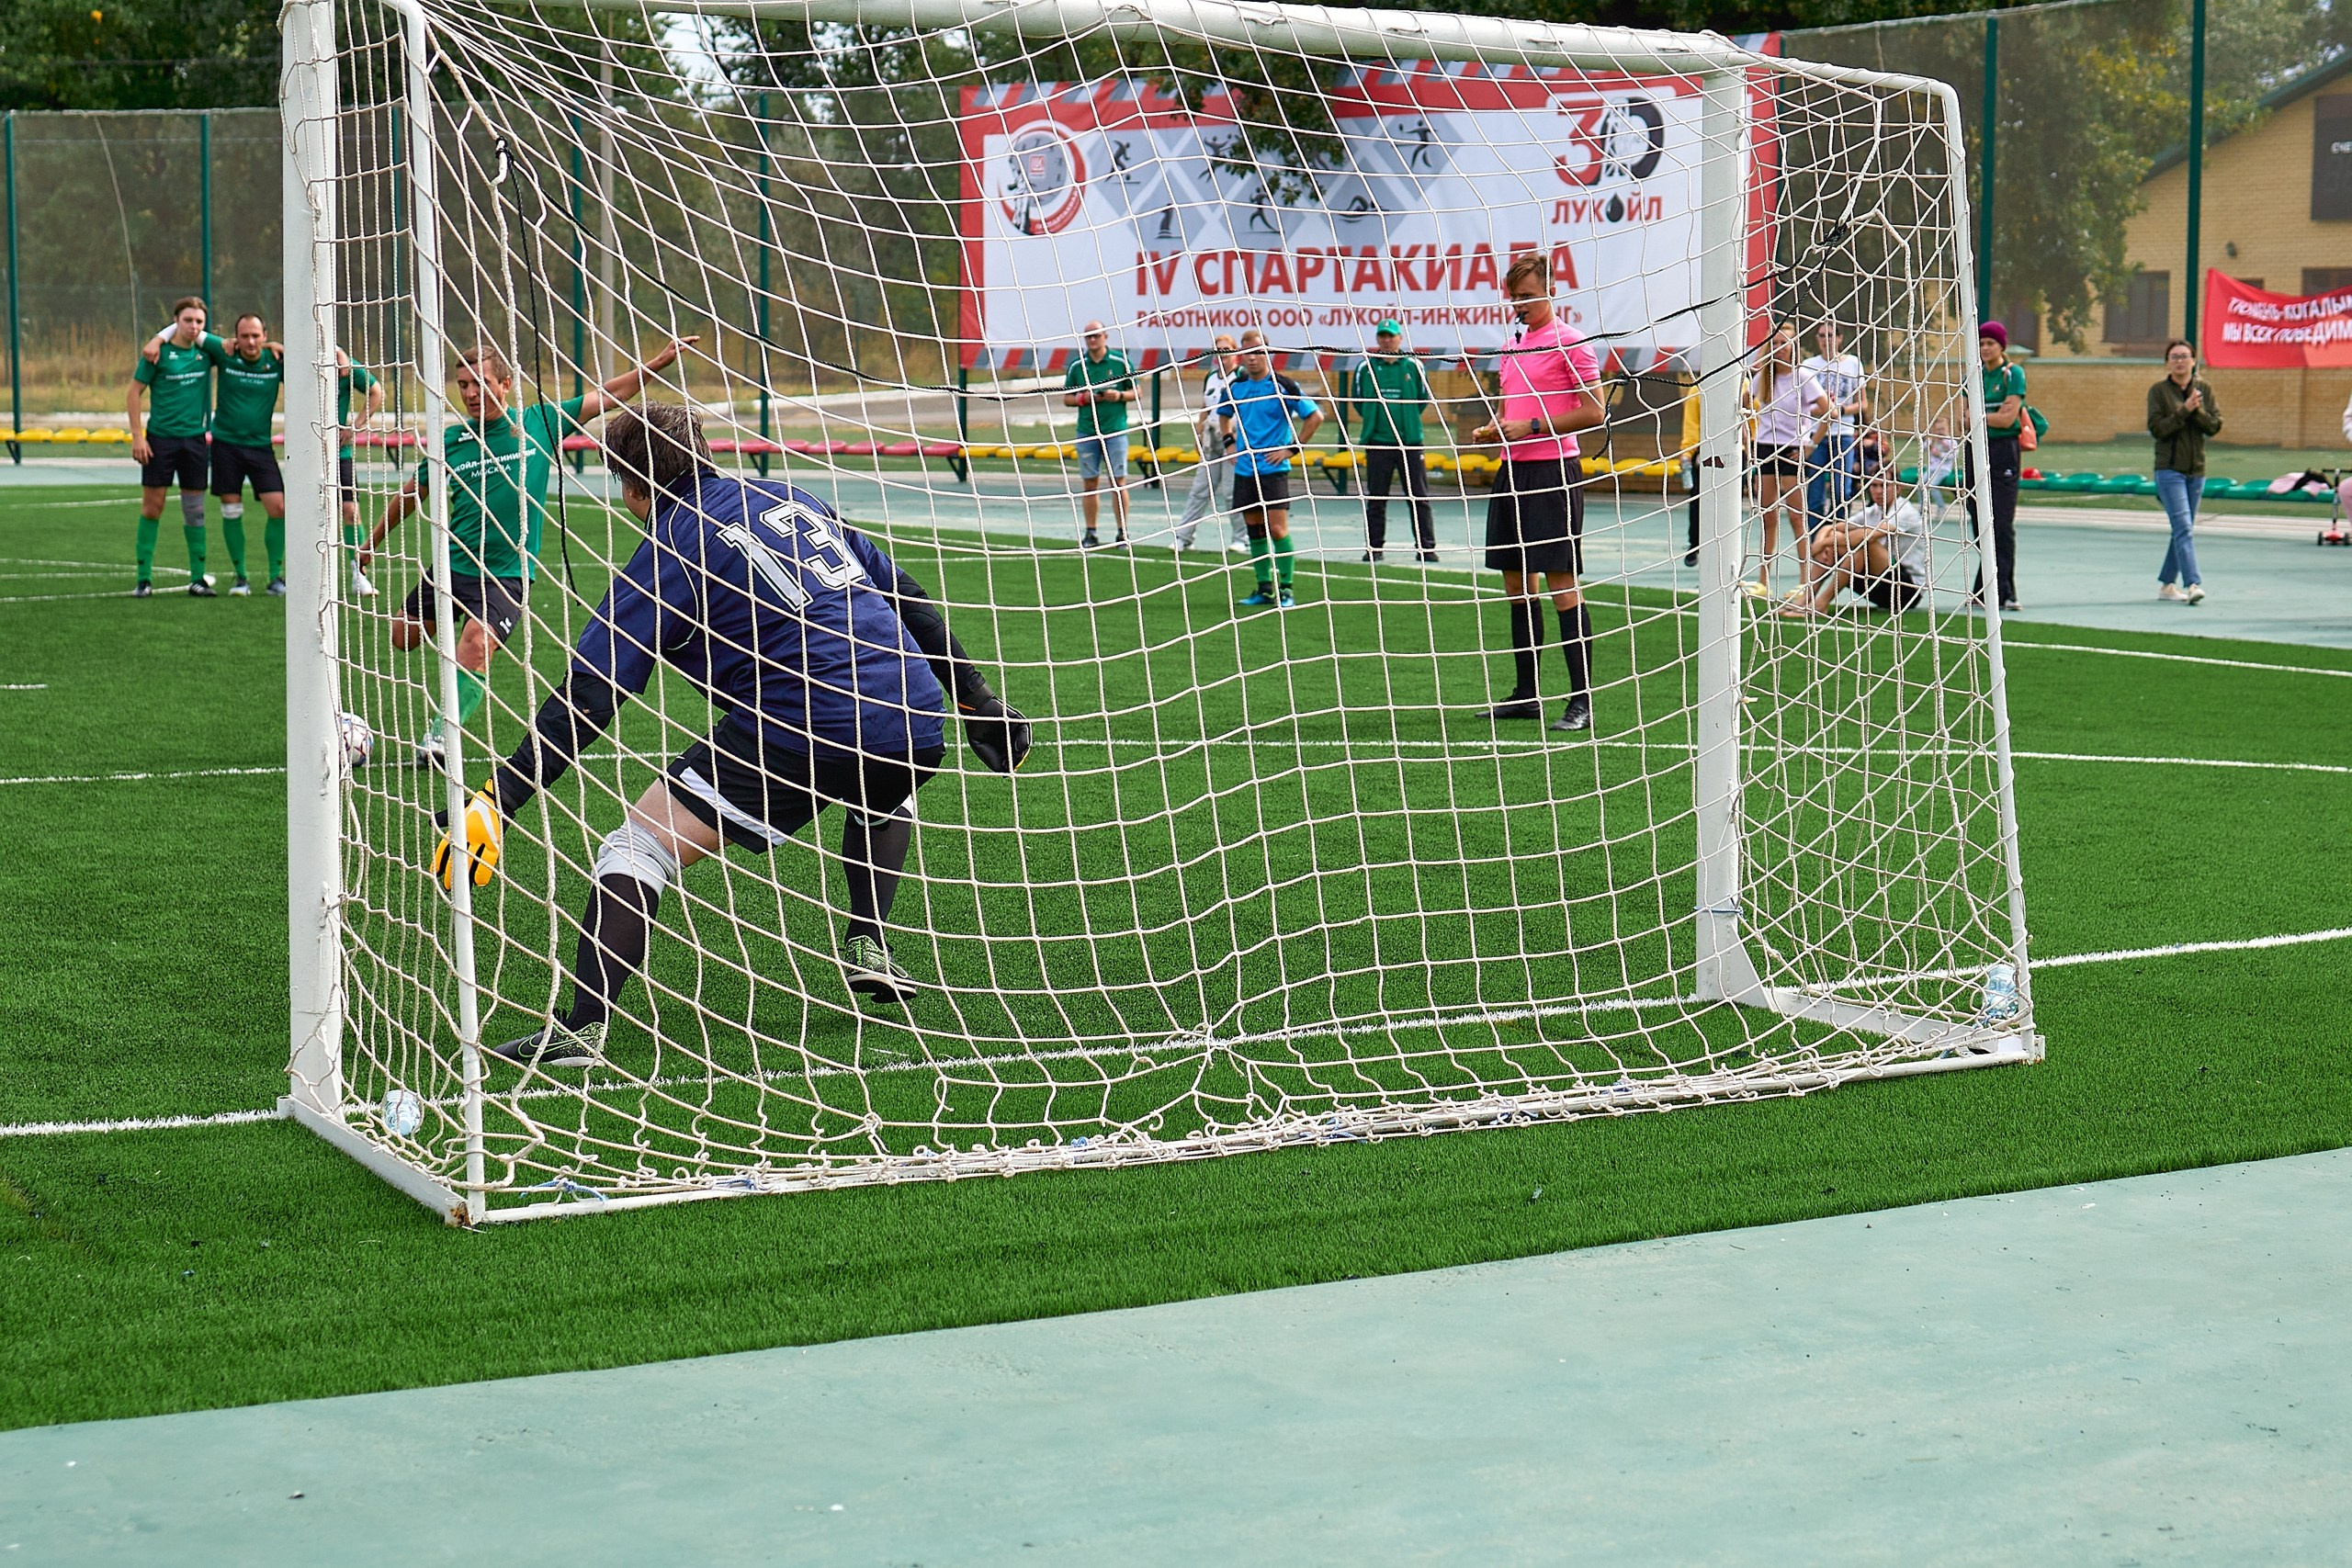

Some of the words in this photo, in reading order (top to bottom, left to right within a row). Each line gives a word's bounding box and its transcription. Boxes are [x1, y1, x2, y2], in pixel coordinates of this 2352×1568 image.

[1136, 251, 1182, 296] IV
[1136, 308, 1261, 328] РАБОТНИКОВ
[1267, 308, 1313, 327] ООО
[1318, 302, 1583, 327] «ЛУКОЙЛ-ИНЖИНИГ»
[716, 500, 867, 613] 13
